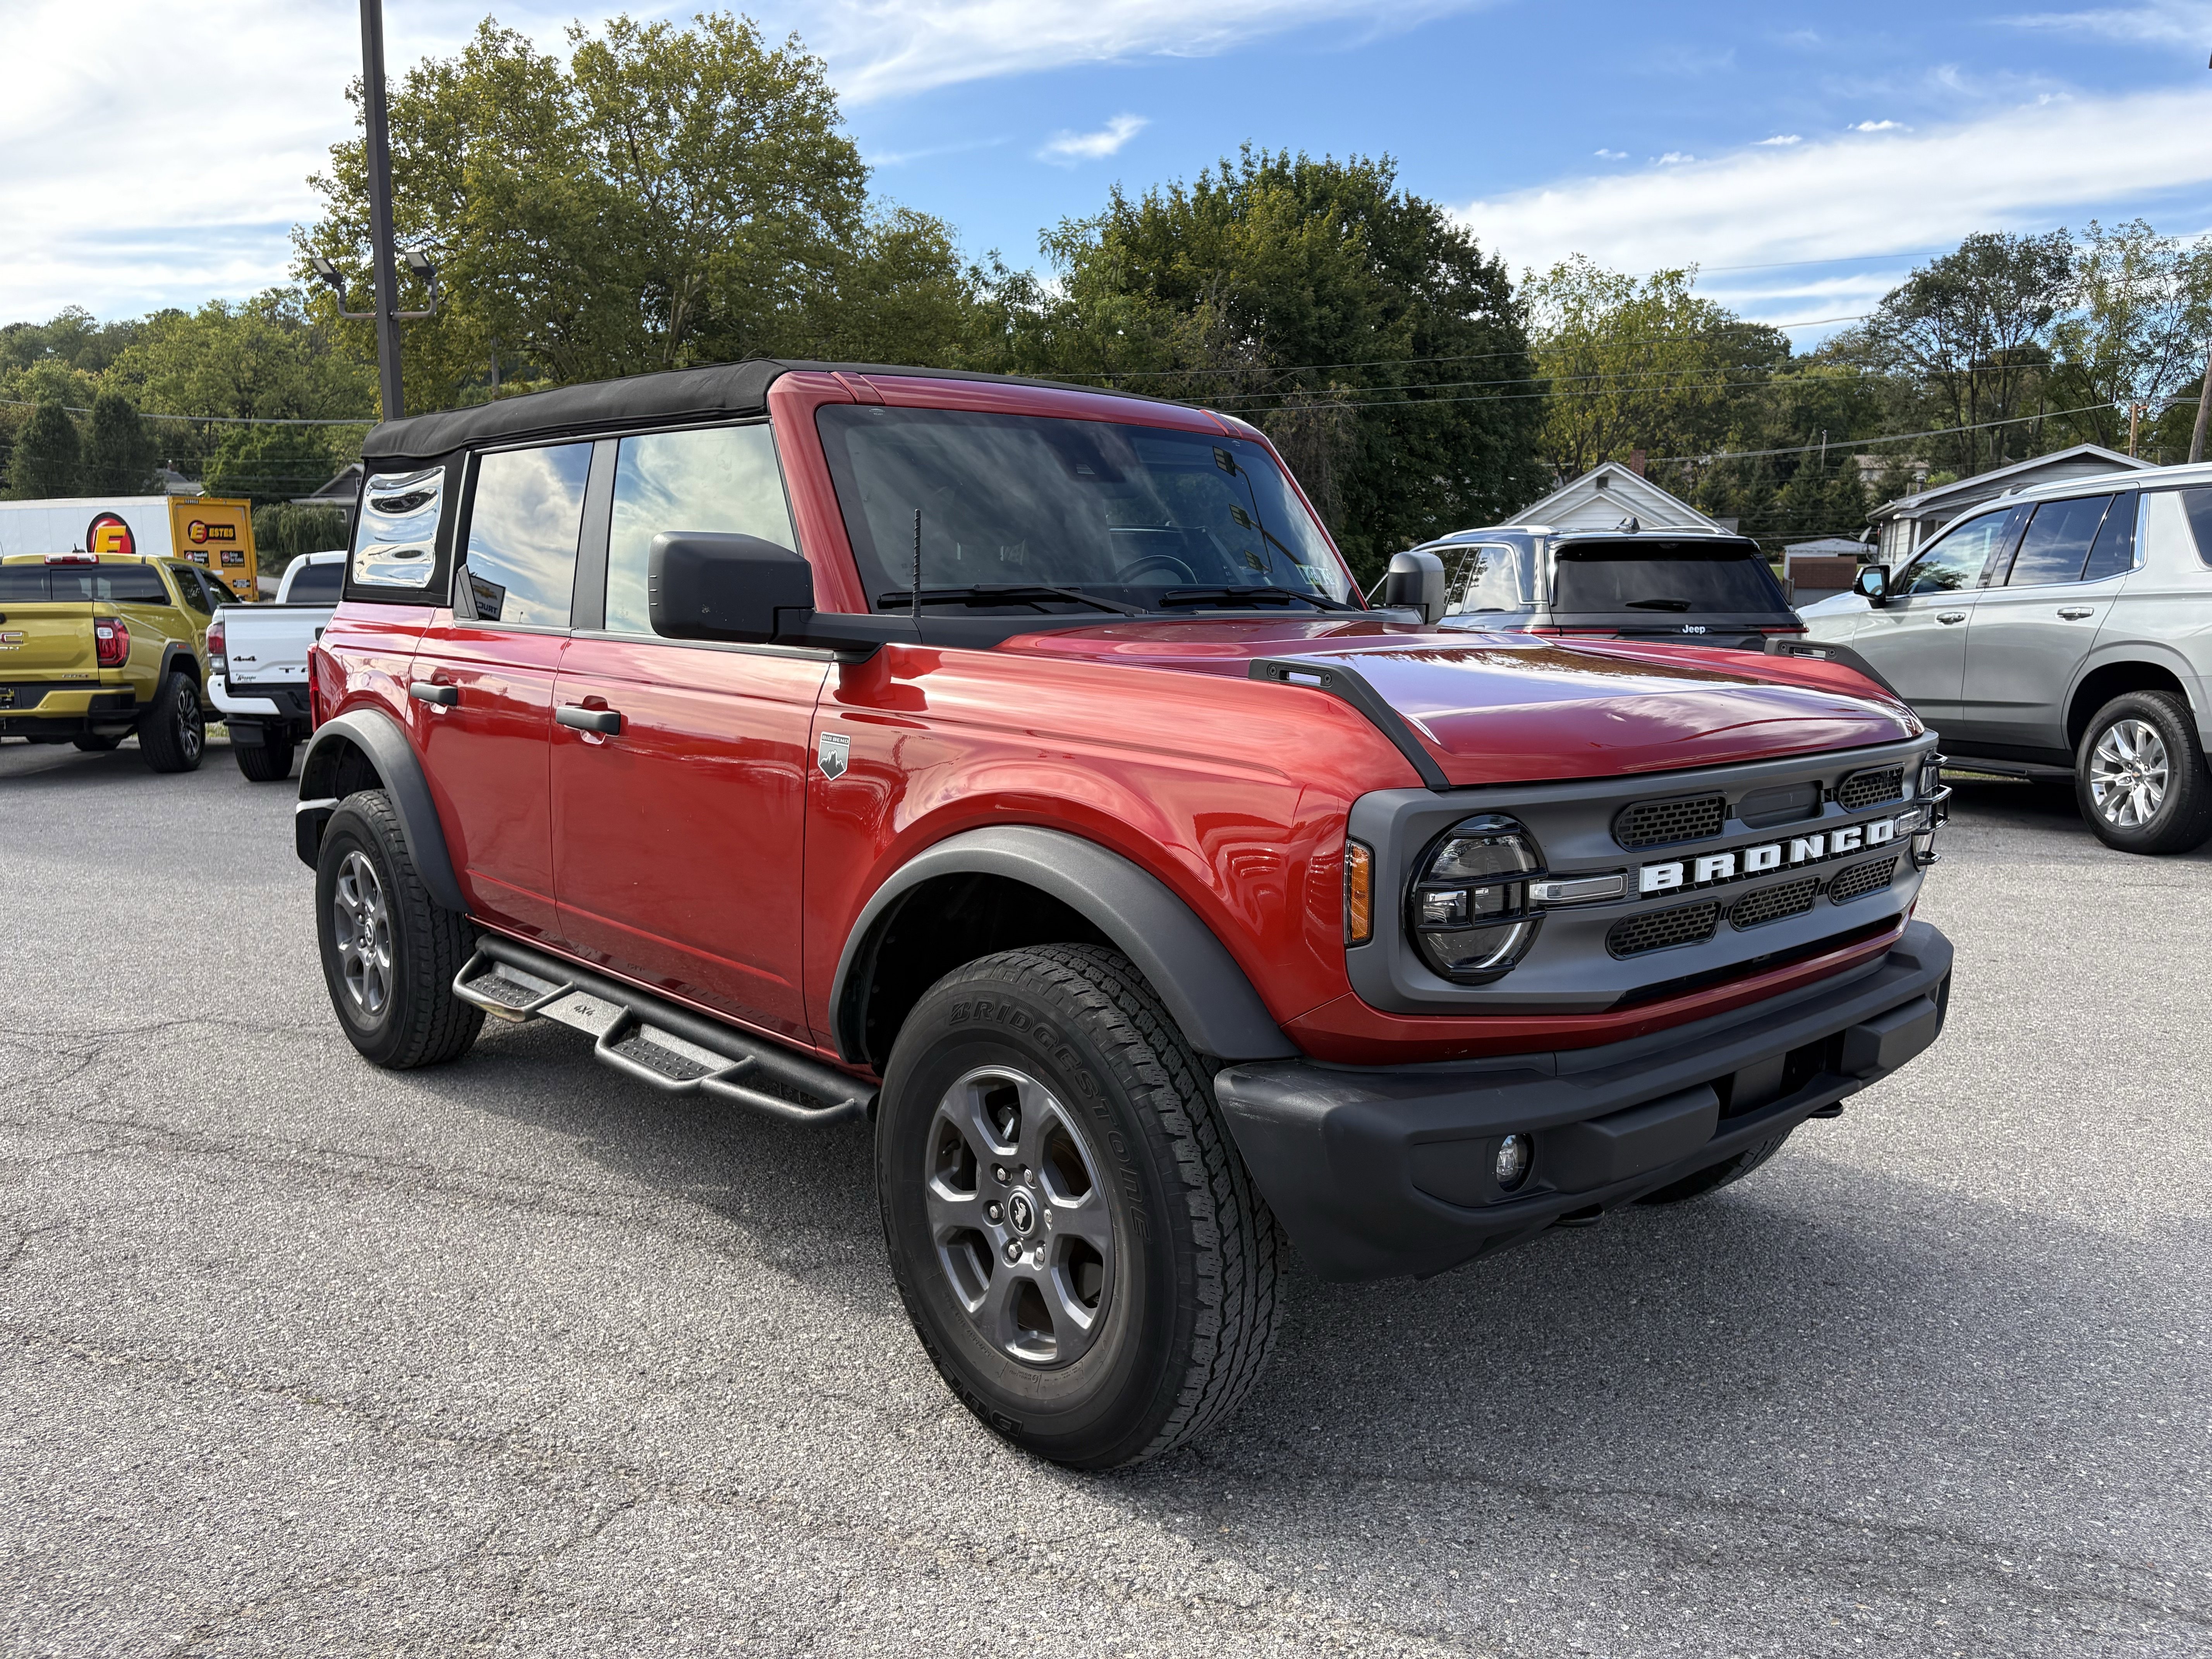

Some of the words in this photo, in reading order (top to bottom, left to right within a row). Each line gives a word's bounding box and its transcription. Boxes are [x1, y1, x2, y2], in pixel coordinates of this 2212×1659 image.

[209, 527, 233, 538] ESTES
[1682, 624, 1706, 635] Jeep
[1639, 819, 1894, 894] BRONCO
[949, 998, 1150, 1239] BRIDGESTONE
